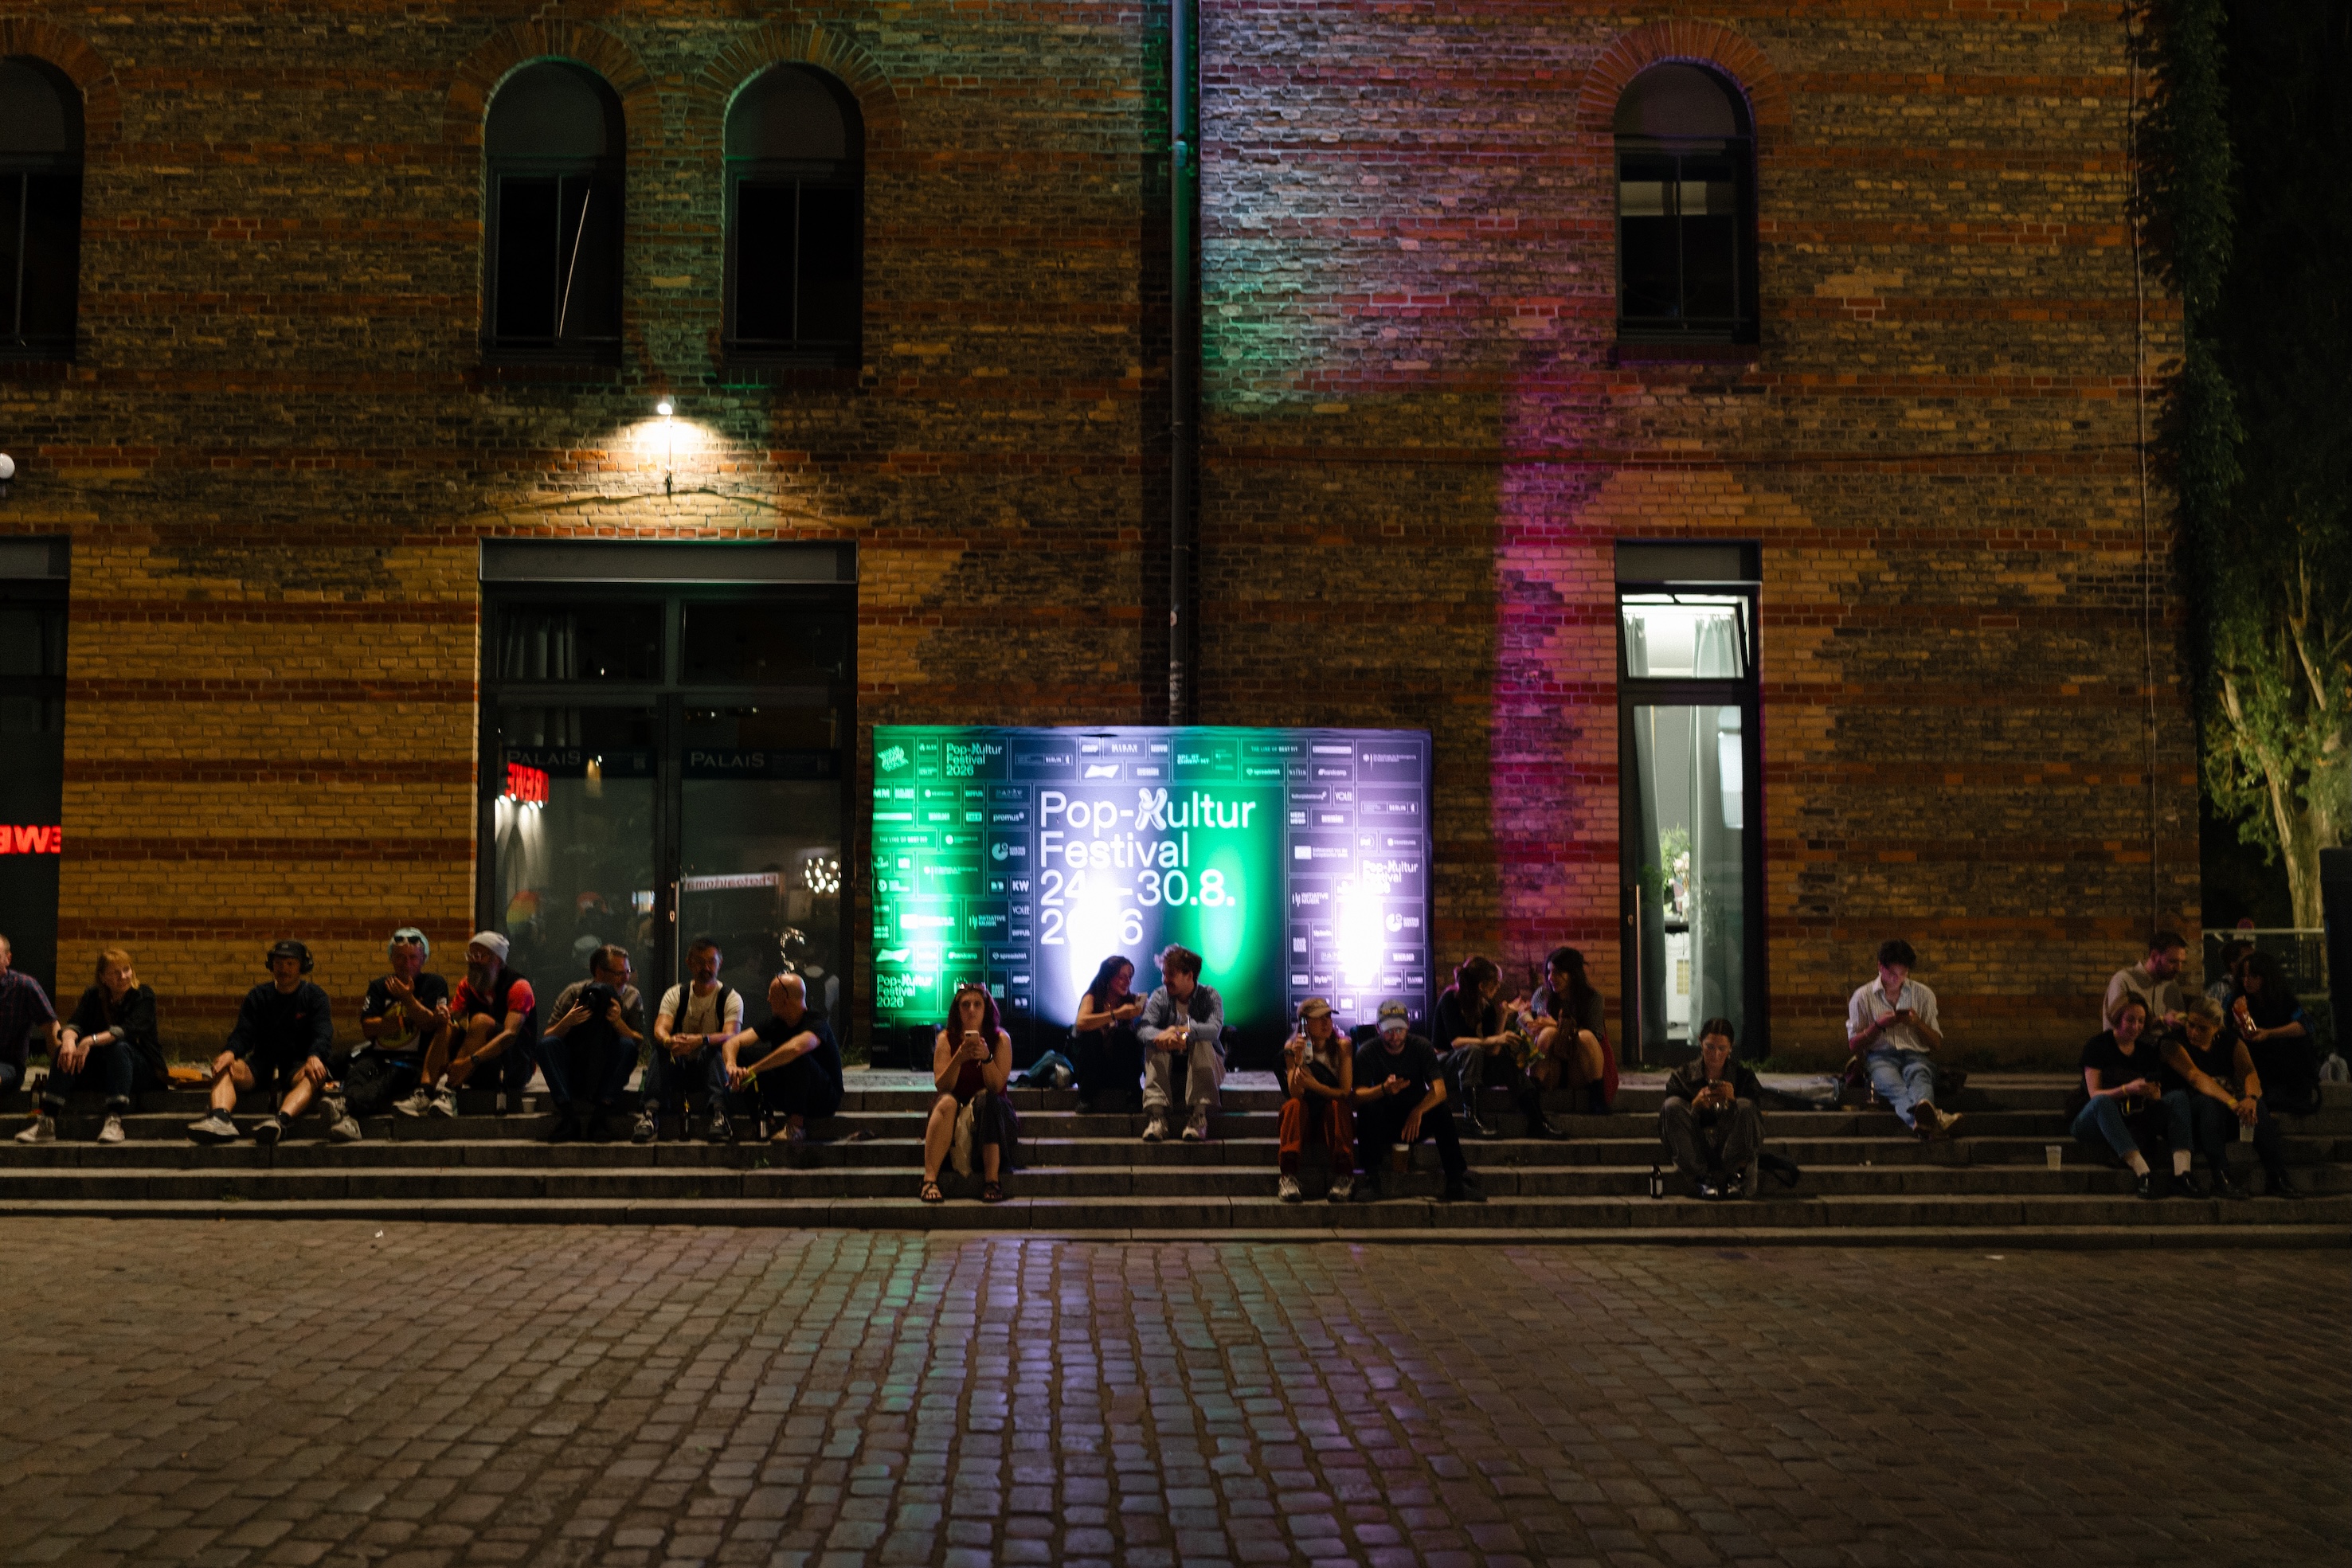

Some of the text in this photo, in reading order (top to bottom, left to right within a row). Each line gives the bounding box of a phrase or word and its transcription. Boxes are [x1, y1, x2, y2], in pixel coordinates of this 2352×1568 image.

[946, 742, 1002, 755] Pop-Kultur
[507, 750, 581, 765] PALAIS
[691, 750, 765, 768] PALAIS
[946, 755, 985, 764] Festival
[946, 764, 974, 776] 2026
[1040, 788, 1256, 837] Pop-Kultur
[1040, 831, 1188, 869] Festival
[1012, 880, 1029, 892] KW
[1040, 908, 1143, 945] 26
[876, 973, 933, 987] Pop-Kultur
[876, 986, 915, 997] Festival
[876, 996, 904, 1008] 2026
